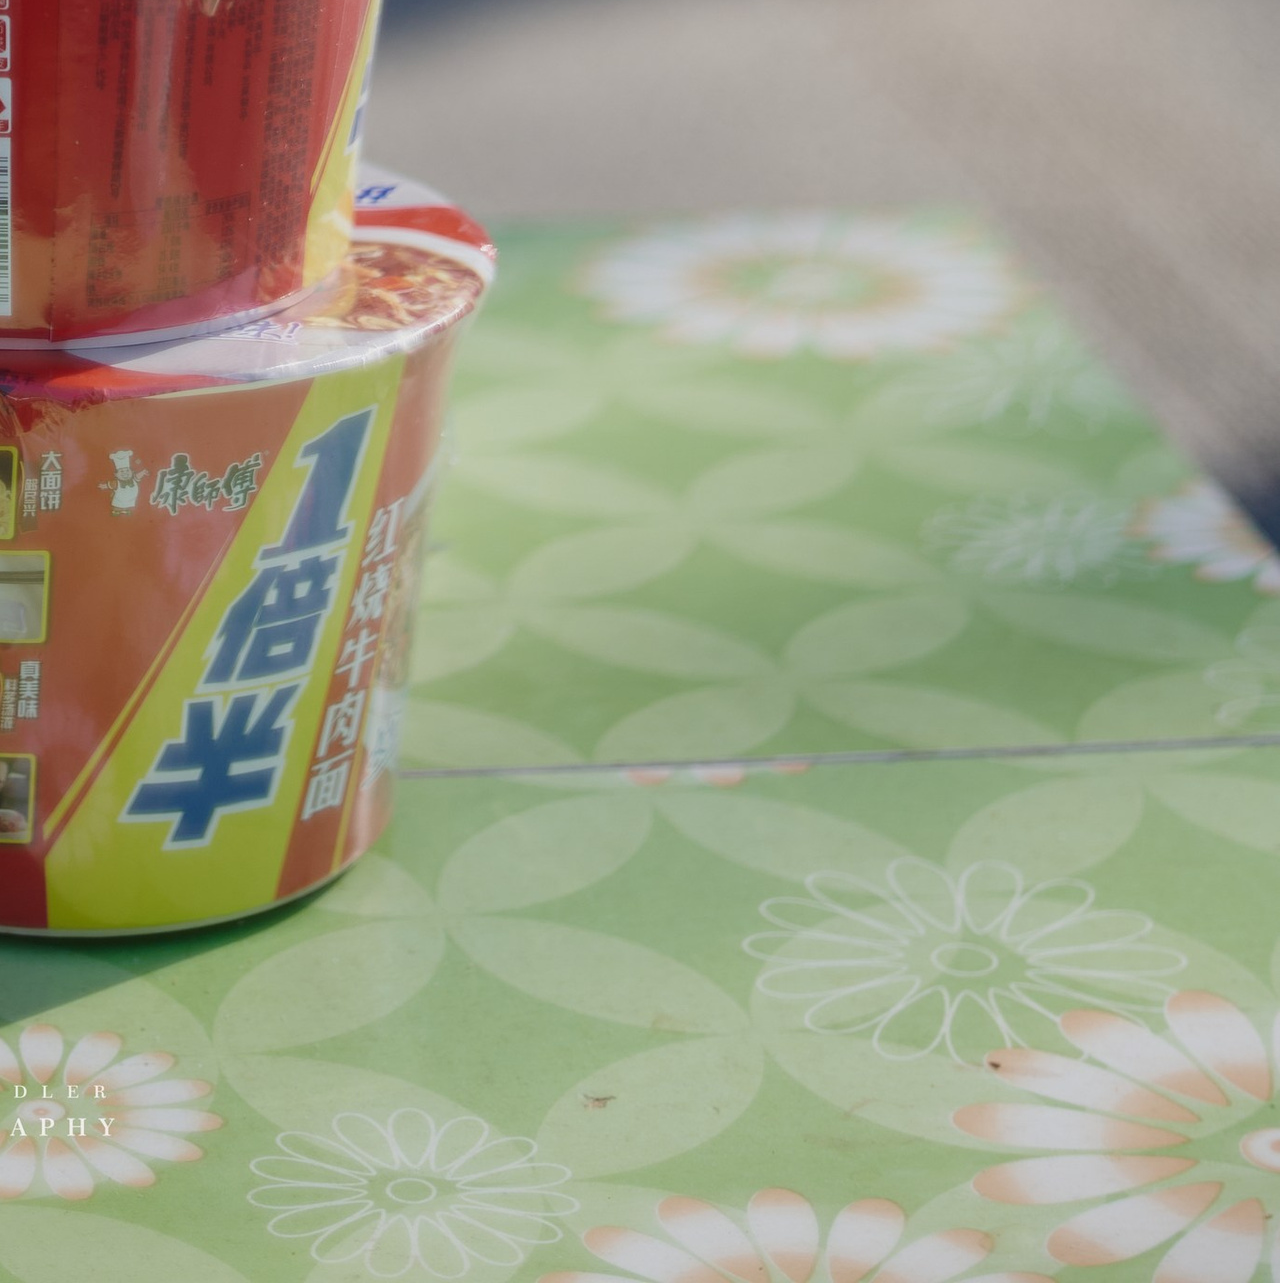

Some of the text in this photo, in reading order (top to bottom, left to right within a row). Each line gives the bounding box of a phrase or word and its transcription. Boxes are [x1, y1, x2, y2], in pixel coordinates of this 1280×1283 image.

[40, 450, 62, 510] 大面饼
[152, 452, 261, 516] 康師傅
[131, 411, 371, 843] 1倍半
[301, 497, 404, 821] 红烧牛肉面
[18, 661, 41, 719] 真美味
